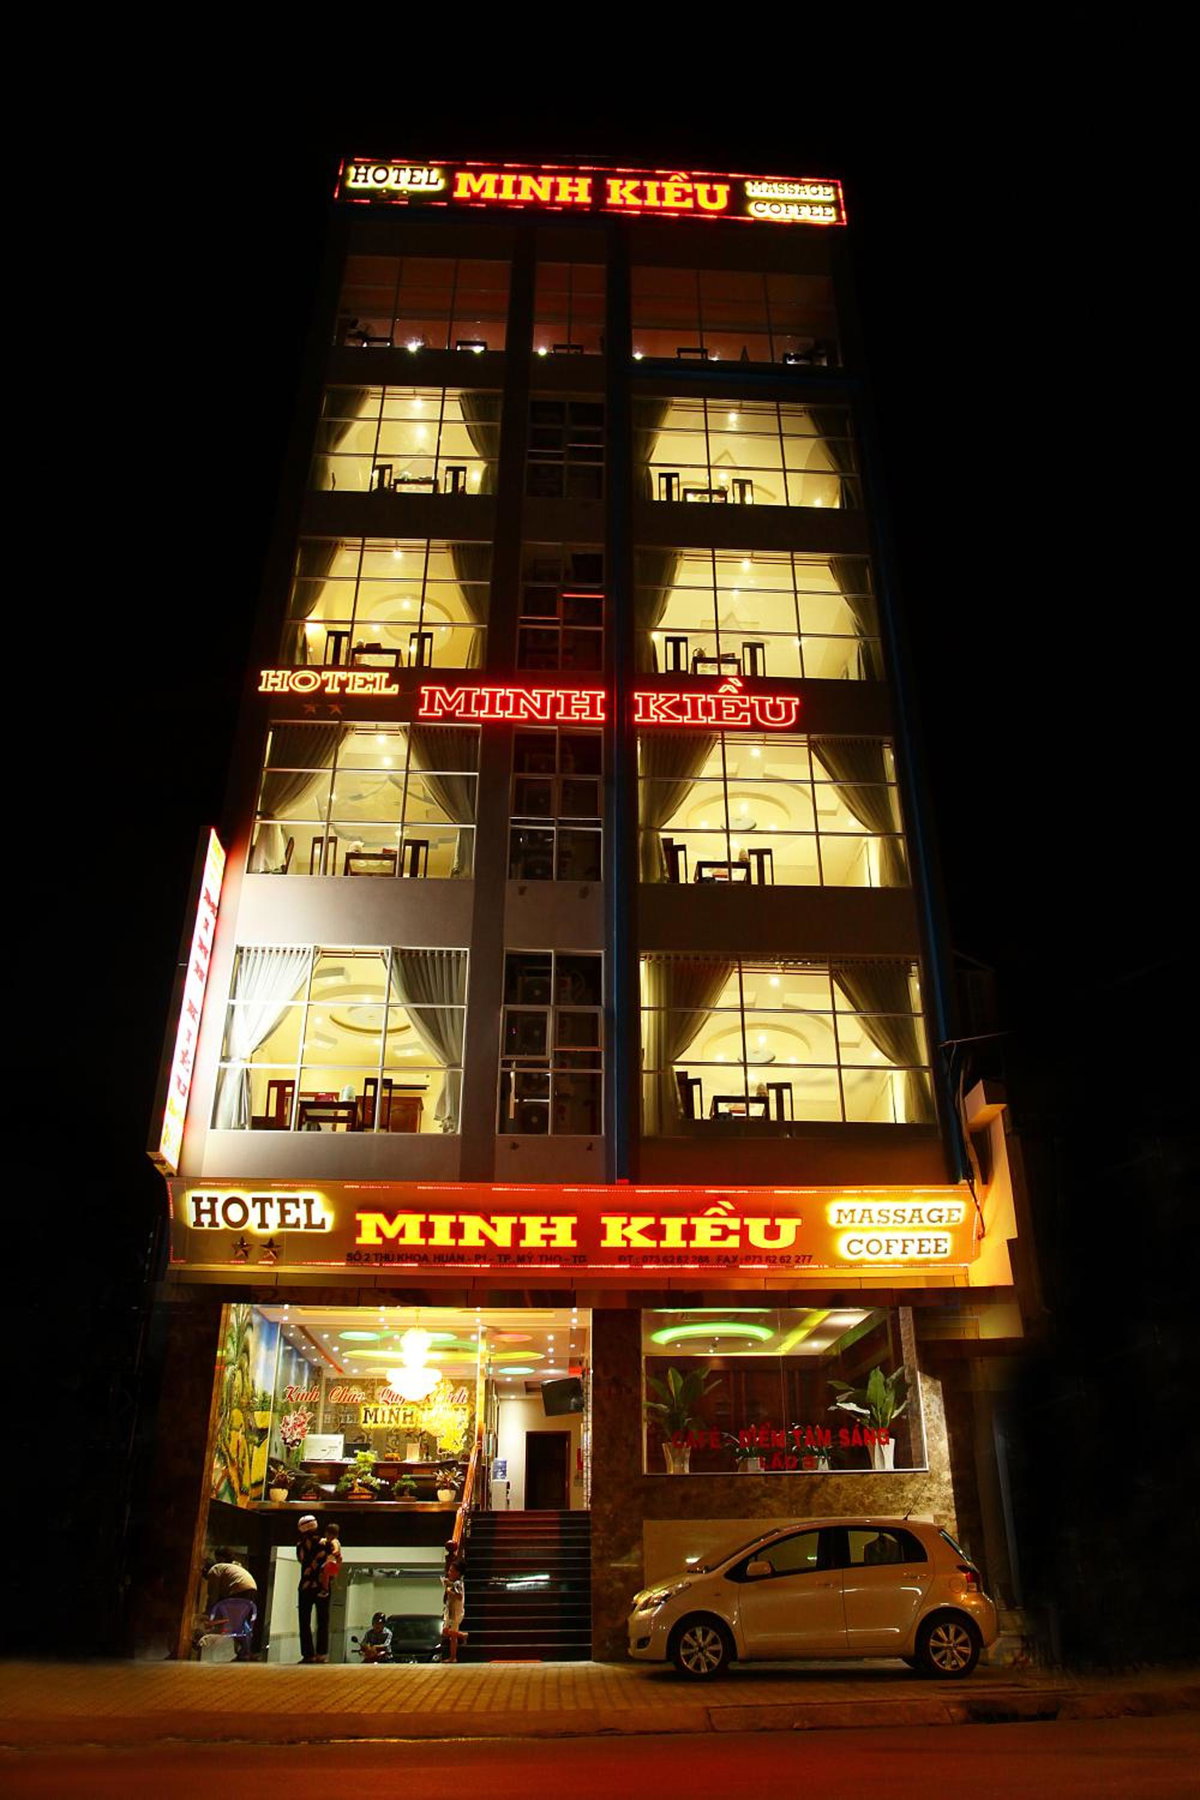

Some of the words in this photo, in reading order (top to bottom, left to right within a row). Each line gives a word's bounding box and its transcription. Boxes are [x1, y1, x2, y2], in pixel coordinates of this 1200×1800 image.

[351, 165, 440, 186] HOTEL
[453, 172, 592, 203] MINH
[606, 172, 730, 210] KIỀU
[750, 181, 832, 197] MASSAGE
[753, 201, 833, 217] COFFEE
[258, 670, 399, 694] HOTEL
[418, 686, 605, 721] MINH
[634, 677, 800, 727] KIỀU
[191, 1196, 326, 1230] HOTEL
[835, 1207, 962, 1225] MASSAGE
[355, 1212, 578, 1248] MINH
[600, 1200, 802, 1250] KIỀU
[846, 1237, 949, 1256] COFFEE
[363, 1252, 371, 1262] 2
[397, 1253, 429, 1263] KHOA
[780, 1254, 792, 1264] 62
[794, 1254, 813, 1264] 277
[362, 1407, 416, 1425] MINH
